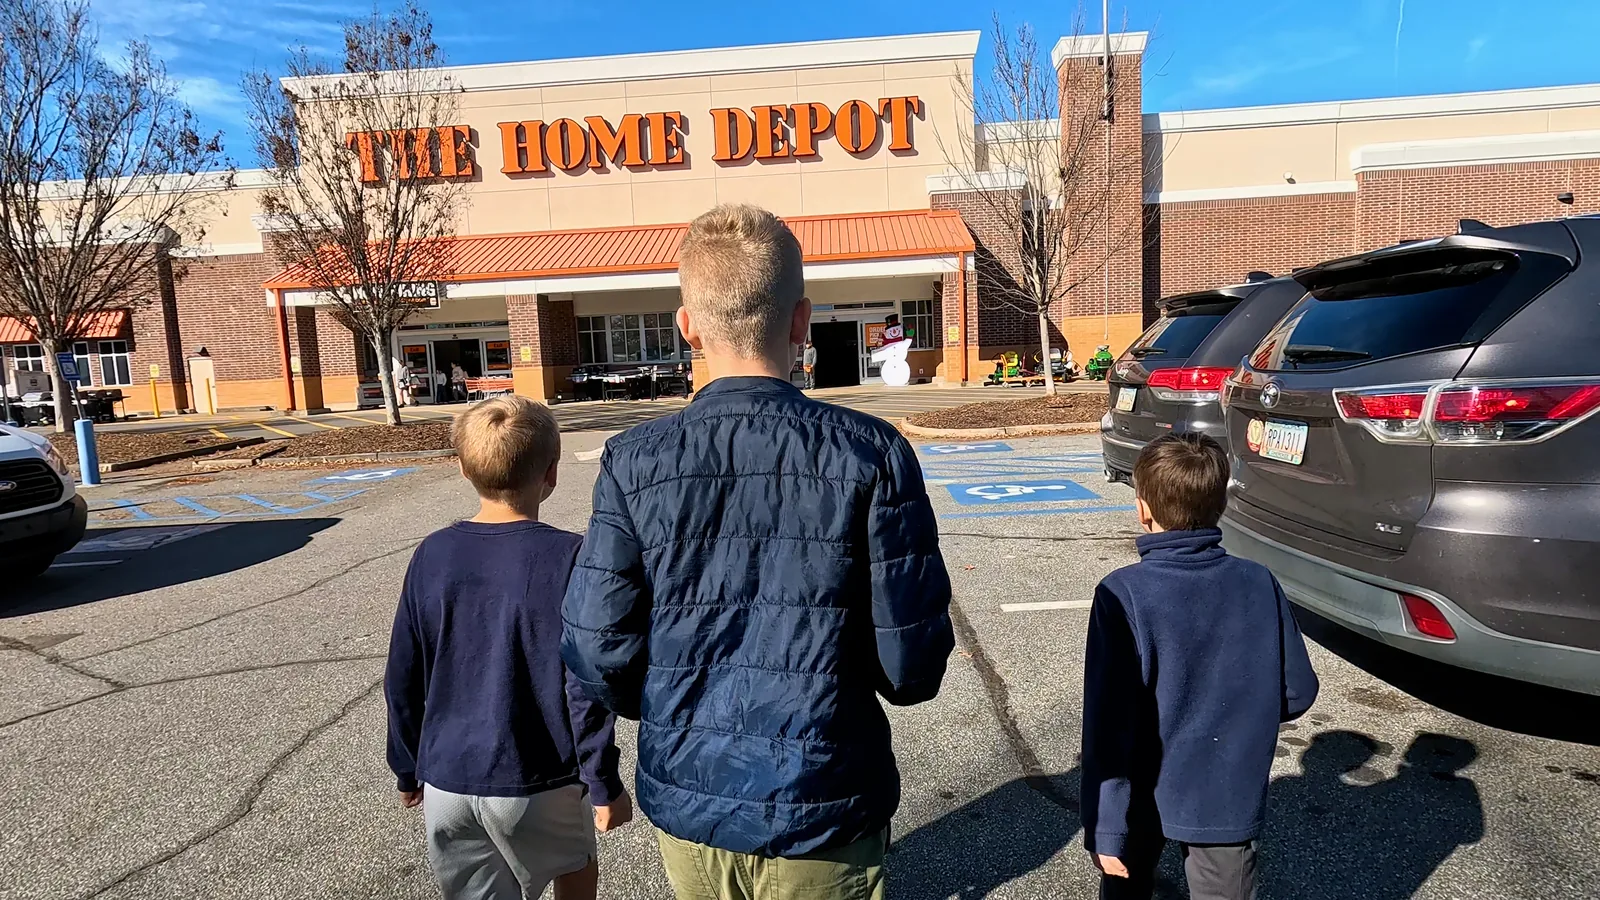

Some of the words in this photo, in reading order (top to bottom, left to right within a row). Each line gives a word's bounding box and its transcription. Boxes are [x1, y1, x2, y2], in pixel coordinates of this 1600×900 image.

[345, 125, 474, 182] THE
[496, 111, 685, 174] HOME
[709, 95, 919, 161] DEPOT
